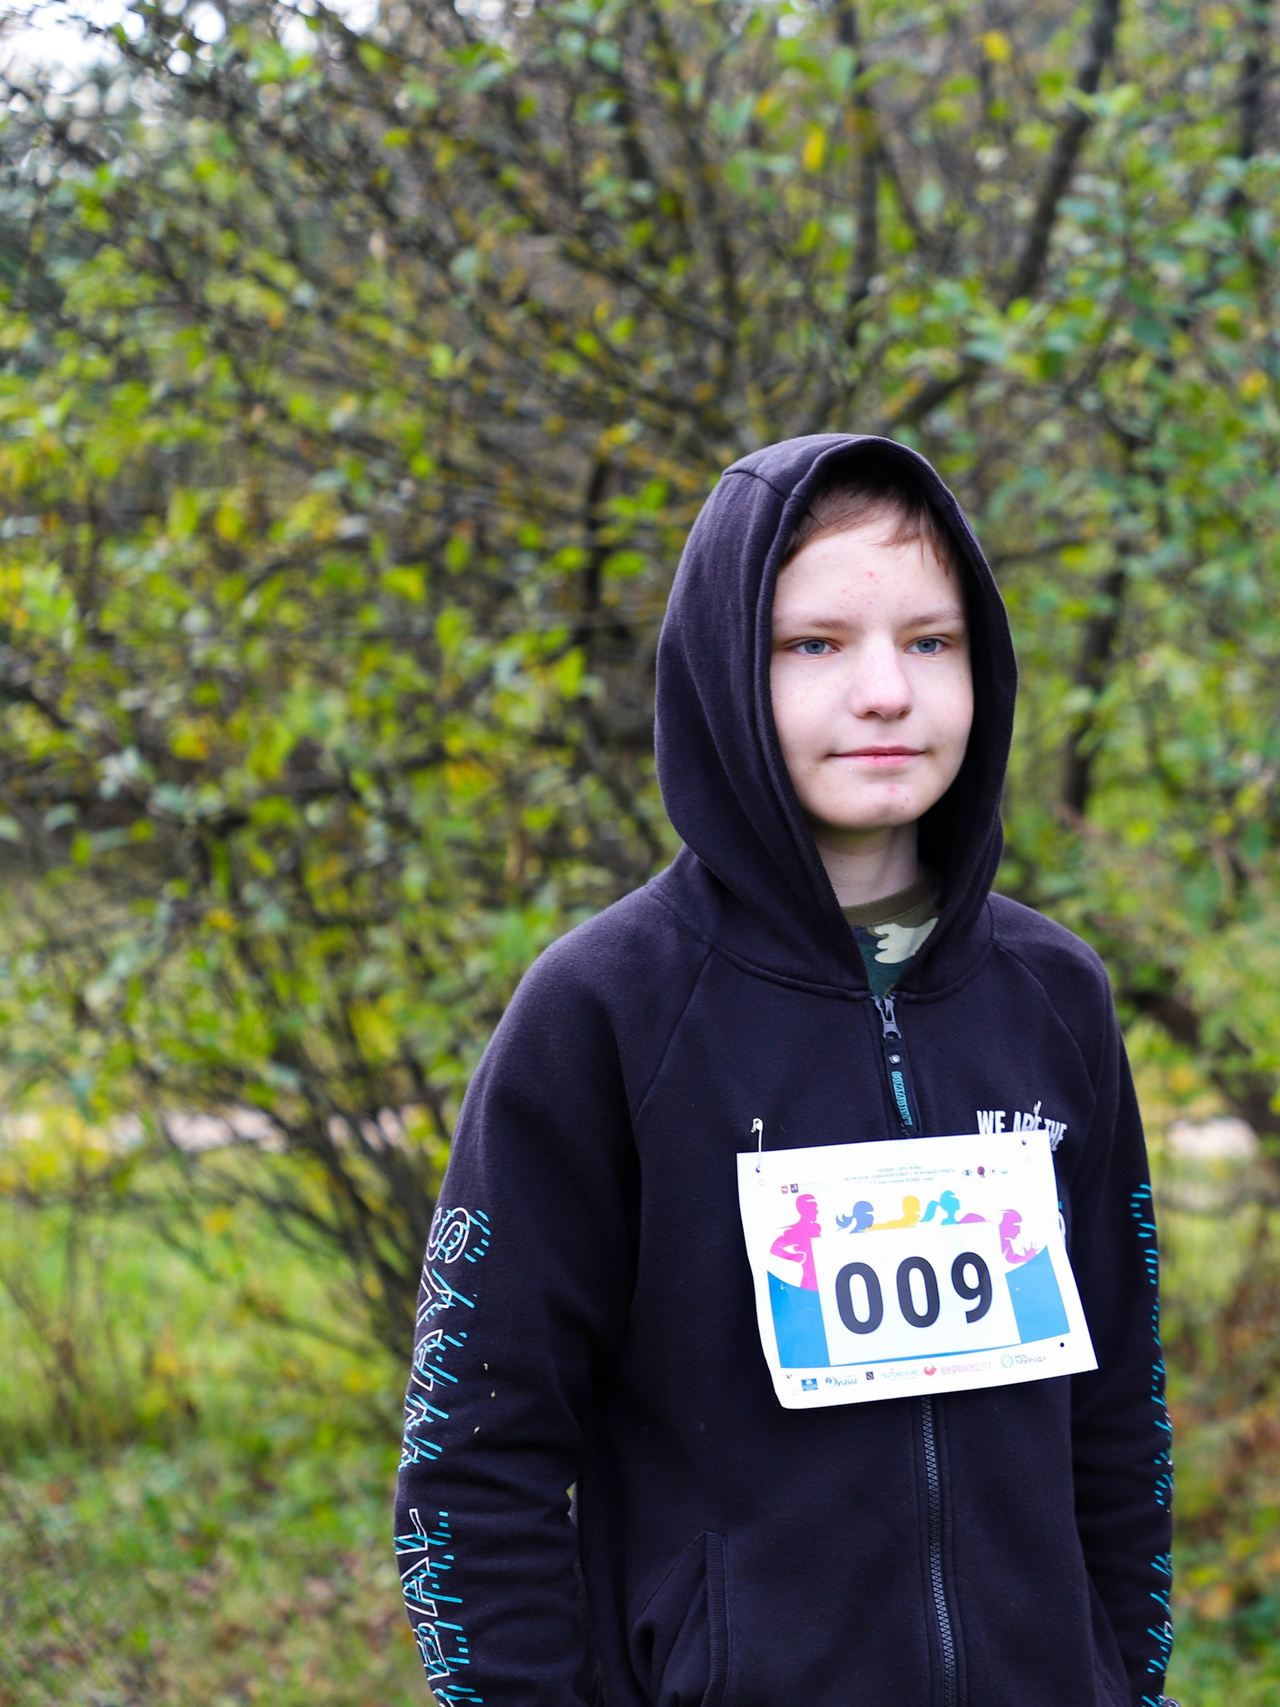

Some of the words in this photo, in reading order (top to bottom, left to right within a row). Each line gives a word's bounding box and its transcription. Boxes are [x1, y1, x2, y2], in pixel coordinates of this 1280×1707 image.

[976, 1110, 1006, 1134] WE
[1043, 1118, 1068, 1151] THE
[834, 1251, 994, 1336] 009
